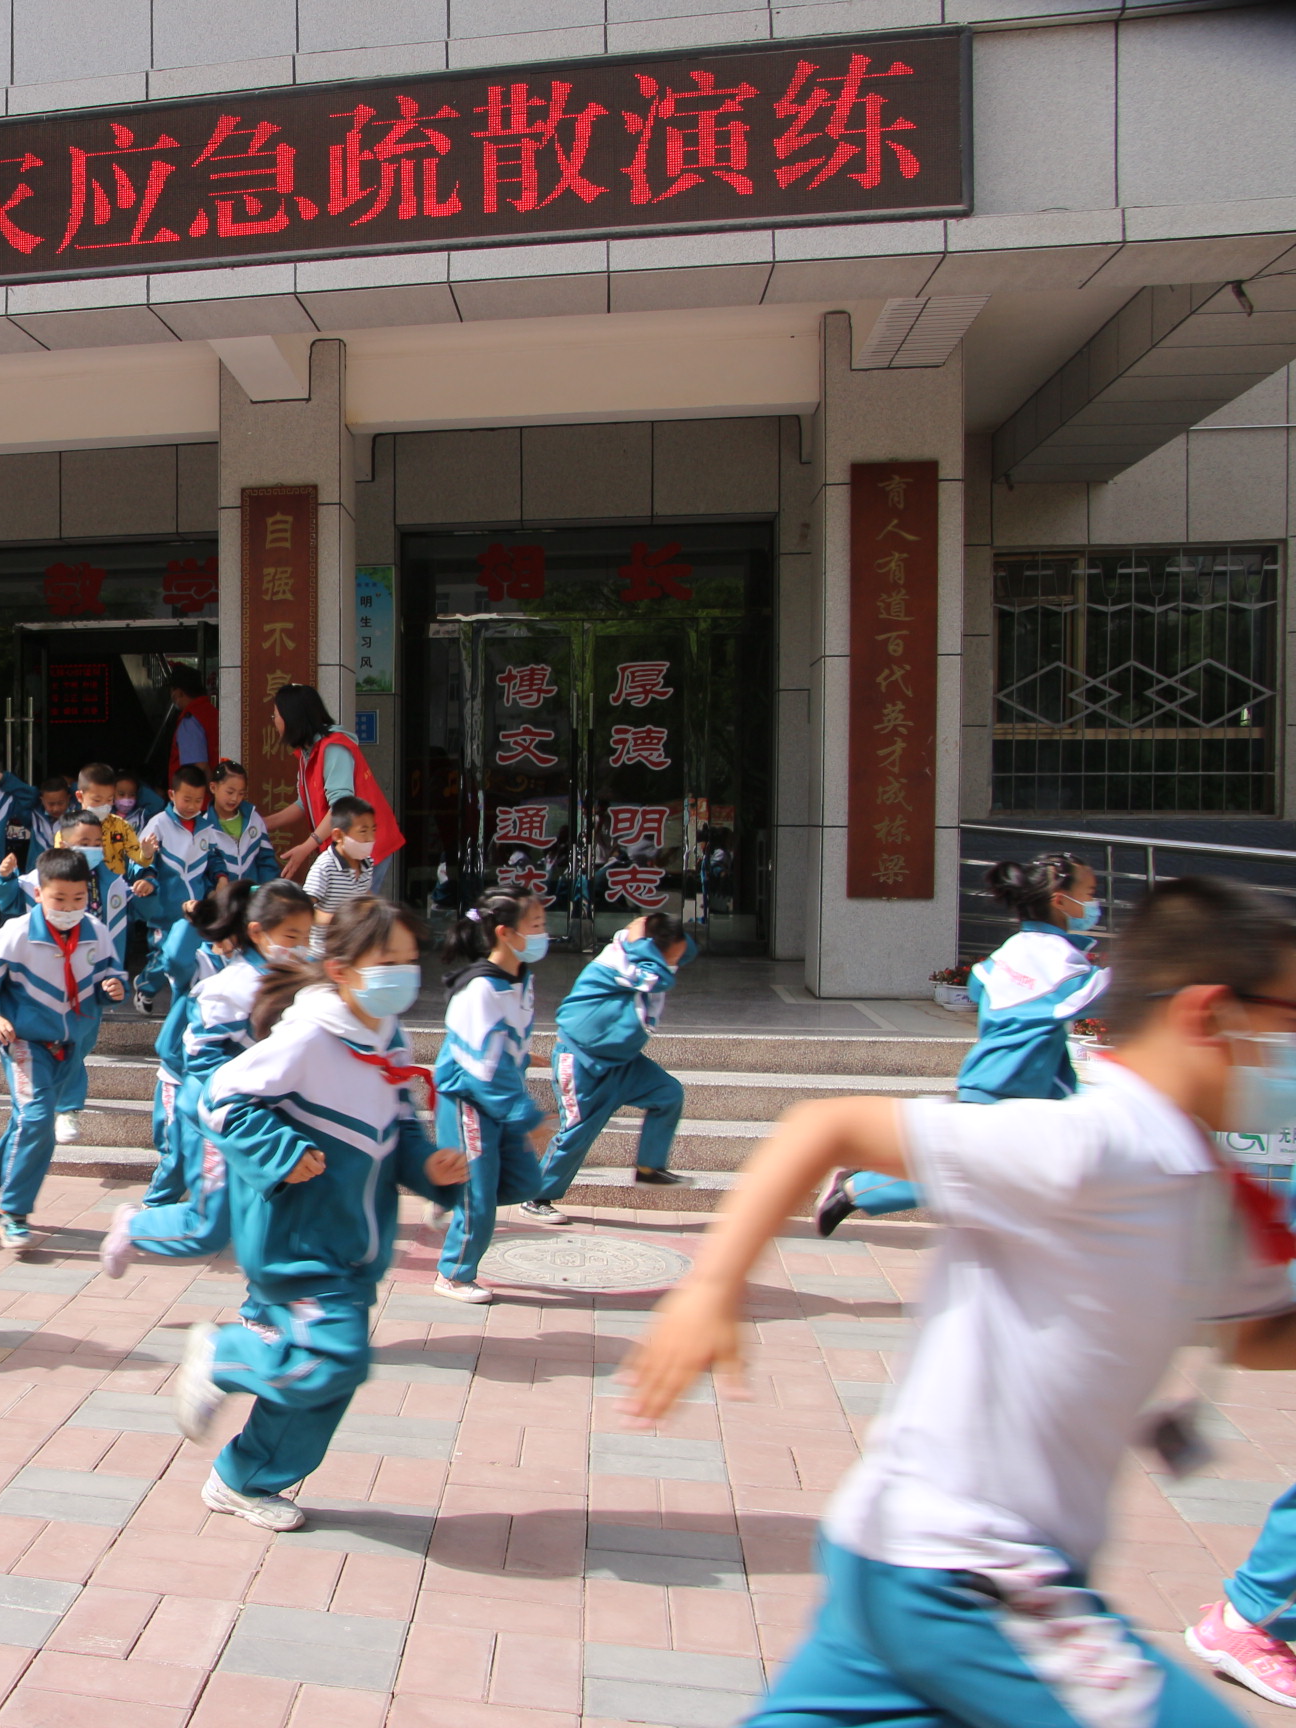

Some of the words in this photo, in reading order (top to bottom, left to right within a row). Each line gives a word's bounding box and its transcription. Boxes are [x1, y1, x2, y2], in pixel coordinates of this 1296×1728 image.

[43, 556, 219, 616] 教学
[476, 542, 694, 602] 相长
[872, 475, 921, 885] 育人有道百代英才成栋梁
[604, 661, 674, 909] 厚德明志
